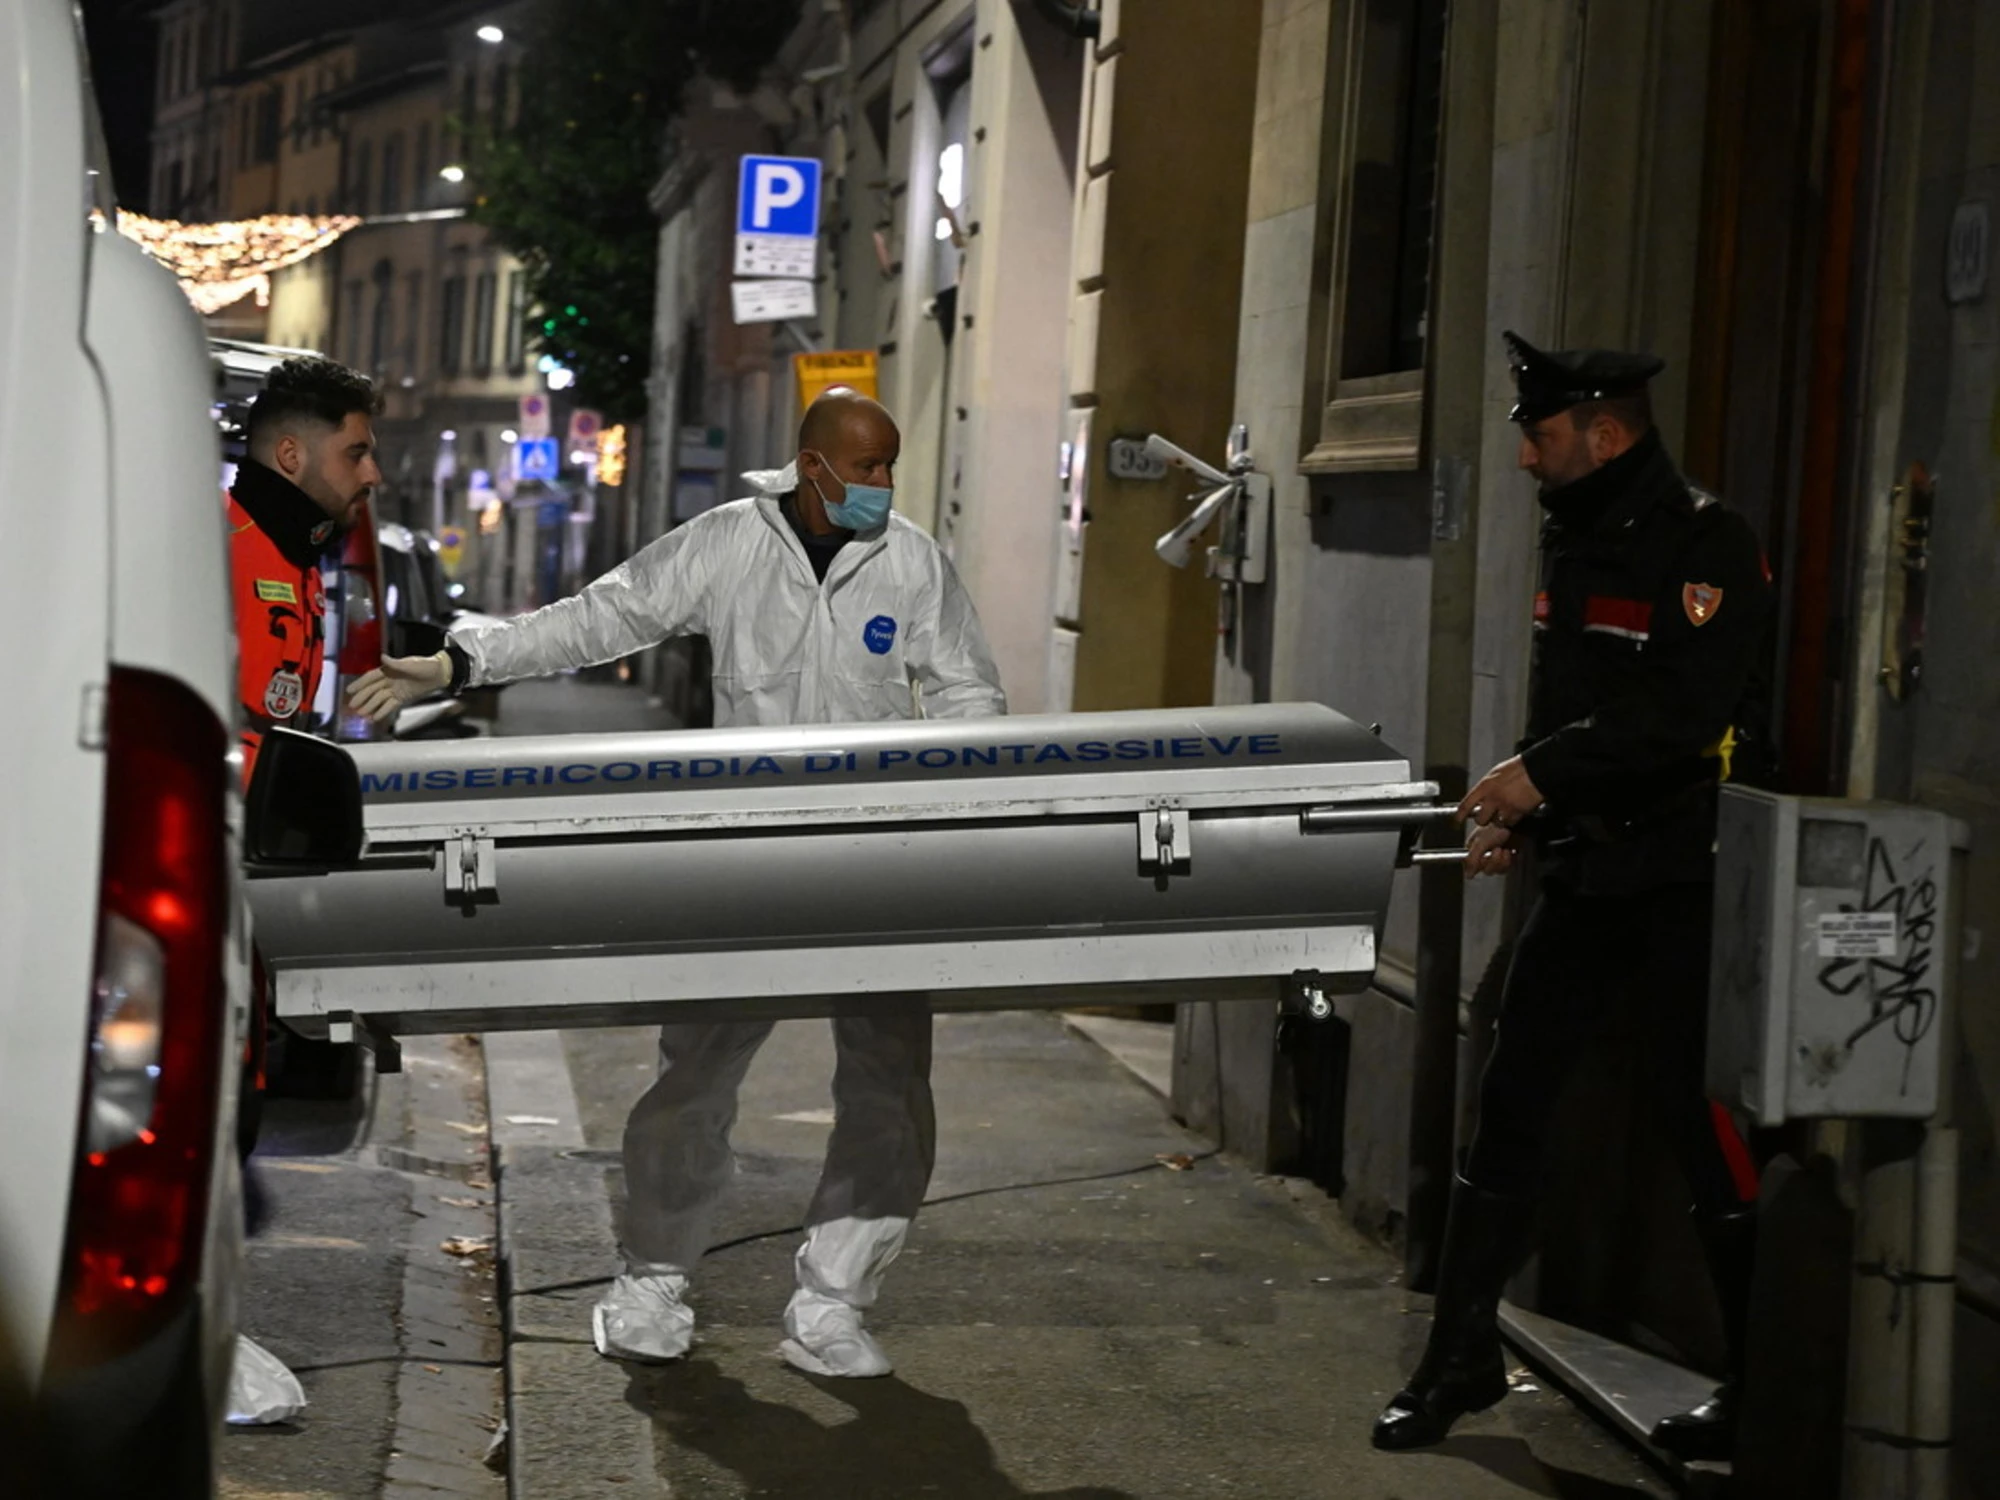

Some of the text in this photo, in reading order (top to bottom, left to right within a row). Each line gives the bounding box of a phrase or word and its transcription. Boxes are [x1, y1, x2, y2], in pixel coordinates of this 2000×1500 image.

[752, 163, 805, 228] P
[360, 735, 1281, 793] MISERICORDIA DI PONTASSIEVE
